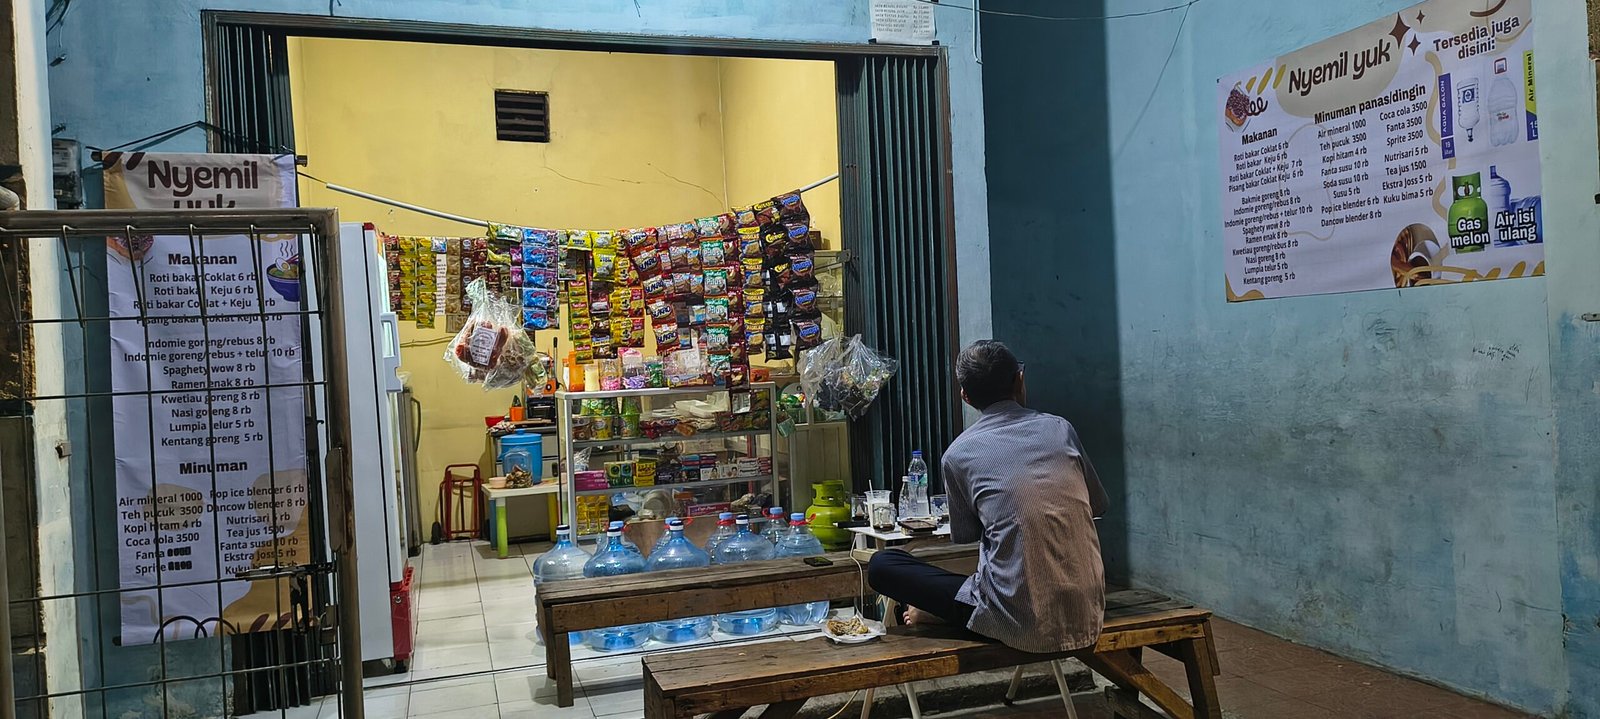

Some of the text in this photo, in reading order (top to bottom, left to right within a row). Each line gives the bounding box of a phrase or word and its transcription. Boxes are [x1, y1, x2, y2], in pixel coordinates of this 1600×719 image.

[1433, 16, 1520, 52] Tersedia juga
[1458, 40, 1495, 59] disini:
[1289, 39, 1390, 96] Nyemil yuk
[1314, 84, 1426, 124] Minuman panas/dingin
[1380, 100, 1428, 121] Coca cola 3500
[1318, 118, 1366, 139] Air mineral 1000
[1386, 116, 1422, 132] Fanta 3500
[1242, 128, 1278, 145] Makanan
[1320, 132, 1366, 151] Teh pucuk 3500
[1386, 130, 1424, 148] Sprite 3500
[1234, 144, 1278, 162] Roti bakar Coklat
[1322, 149, 1354, 164] Kopi hitam
[1384, 148, 1414, 162] Nutrisari
[1236, 155, 1276, 170] Roti bakar Keju
[1321, 160, 1361, 177] Fanta susu 10
[1386, 160, 1426, 176] Tea jus 1500
[148, 160, 258, 196] Nyemil
[1229, 162, 1289, 183] Roti bakar Coklat Keju
[1228, 172, 1290, 193] Pisang bakar Coklat Keju
[1323, 174, 1360, 189] Soda susu 10
[1382, 180, 1403, 190] Ekstra
[1242, 190, 1279, 205] Bakmie goreng
[1333, 190, 1348, 199] Susu
[1383, 190, 1418, 204] Kuku bima
[1234, 206, 1254, 216] Indomie
[1322, 198, 1366, 216] Pop ice blender
[1224, 218, 1244, 228] Indomie
[1284, 208, 1298, 216] telur
[1321, 212, 1368, 227] Dancow blender
[1496, 208, 1534, 227] Air isi
[1266, 222, 1280, 230] wow
[1457, 219, 1481, 231] Gas
[1246, 232, 1276, 244] Ramen enak
[1452, 232, 1489, 247] melon
[1500, 225, 1536, 241] ulang
[1232, 246, 1252, 256] Kwetiau
[1246, 253, 1275, 265] Nasi goreng
[1244, 262, 1277, 275] Lumpia telur
[150, 273, 170, 282] Roti
[204, 272, 236, 282] Coklat
[1243, 274, 1282, 286] Kentang goreng
[154, 286, 232, 296] Roti baka Keju
[134, 298, 252, 310] Rti bakar Colat Keju
[147, 338, 186, 348] ndomie
[124, 352, 166, 362] Indomie
[163, 364, 234, 377] Spaghety wow
[171, 379, 233, 390] Ramen enak
[161, 394, 240, 404] Kwetiau goreng
[172, 408, 230, 418] Nasi goeng
[170, 420, 233, 432] Lumpia elur
[161, 436, 240, 446] Kentang goreng
[179, 461, 248, 474] Minuman
[119, 496, 134, 506] Air
[180, 492, 202, 502] 1000
[210, 490, 228, 500] Pop
[230, 488, 244, 497] ice
[121, 506, 203, 520] Teh pucuk 3500
[206, 503, 246, 513] Dancow
[226, 513, 270, 525] Nutrisari
[124, 522, 180, 534] Kopi htam
[226, 528, 244, 538] Tea
[246, 527, 260, 539] jus
[126, 538, 150, 547] Coca
[176, 532, 200, 543] 3500
[220, 540, 272, 551] Fanta susu
[224, 552, 254, 562] Ekstra
[136, 563, 166, 576] Sprie
